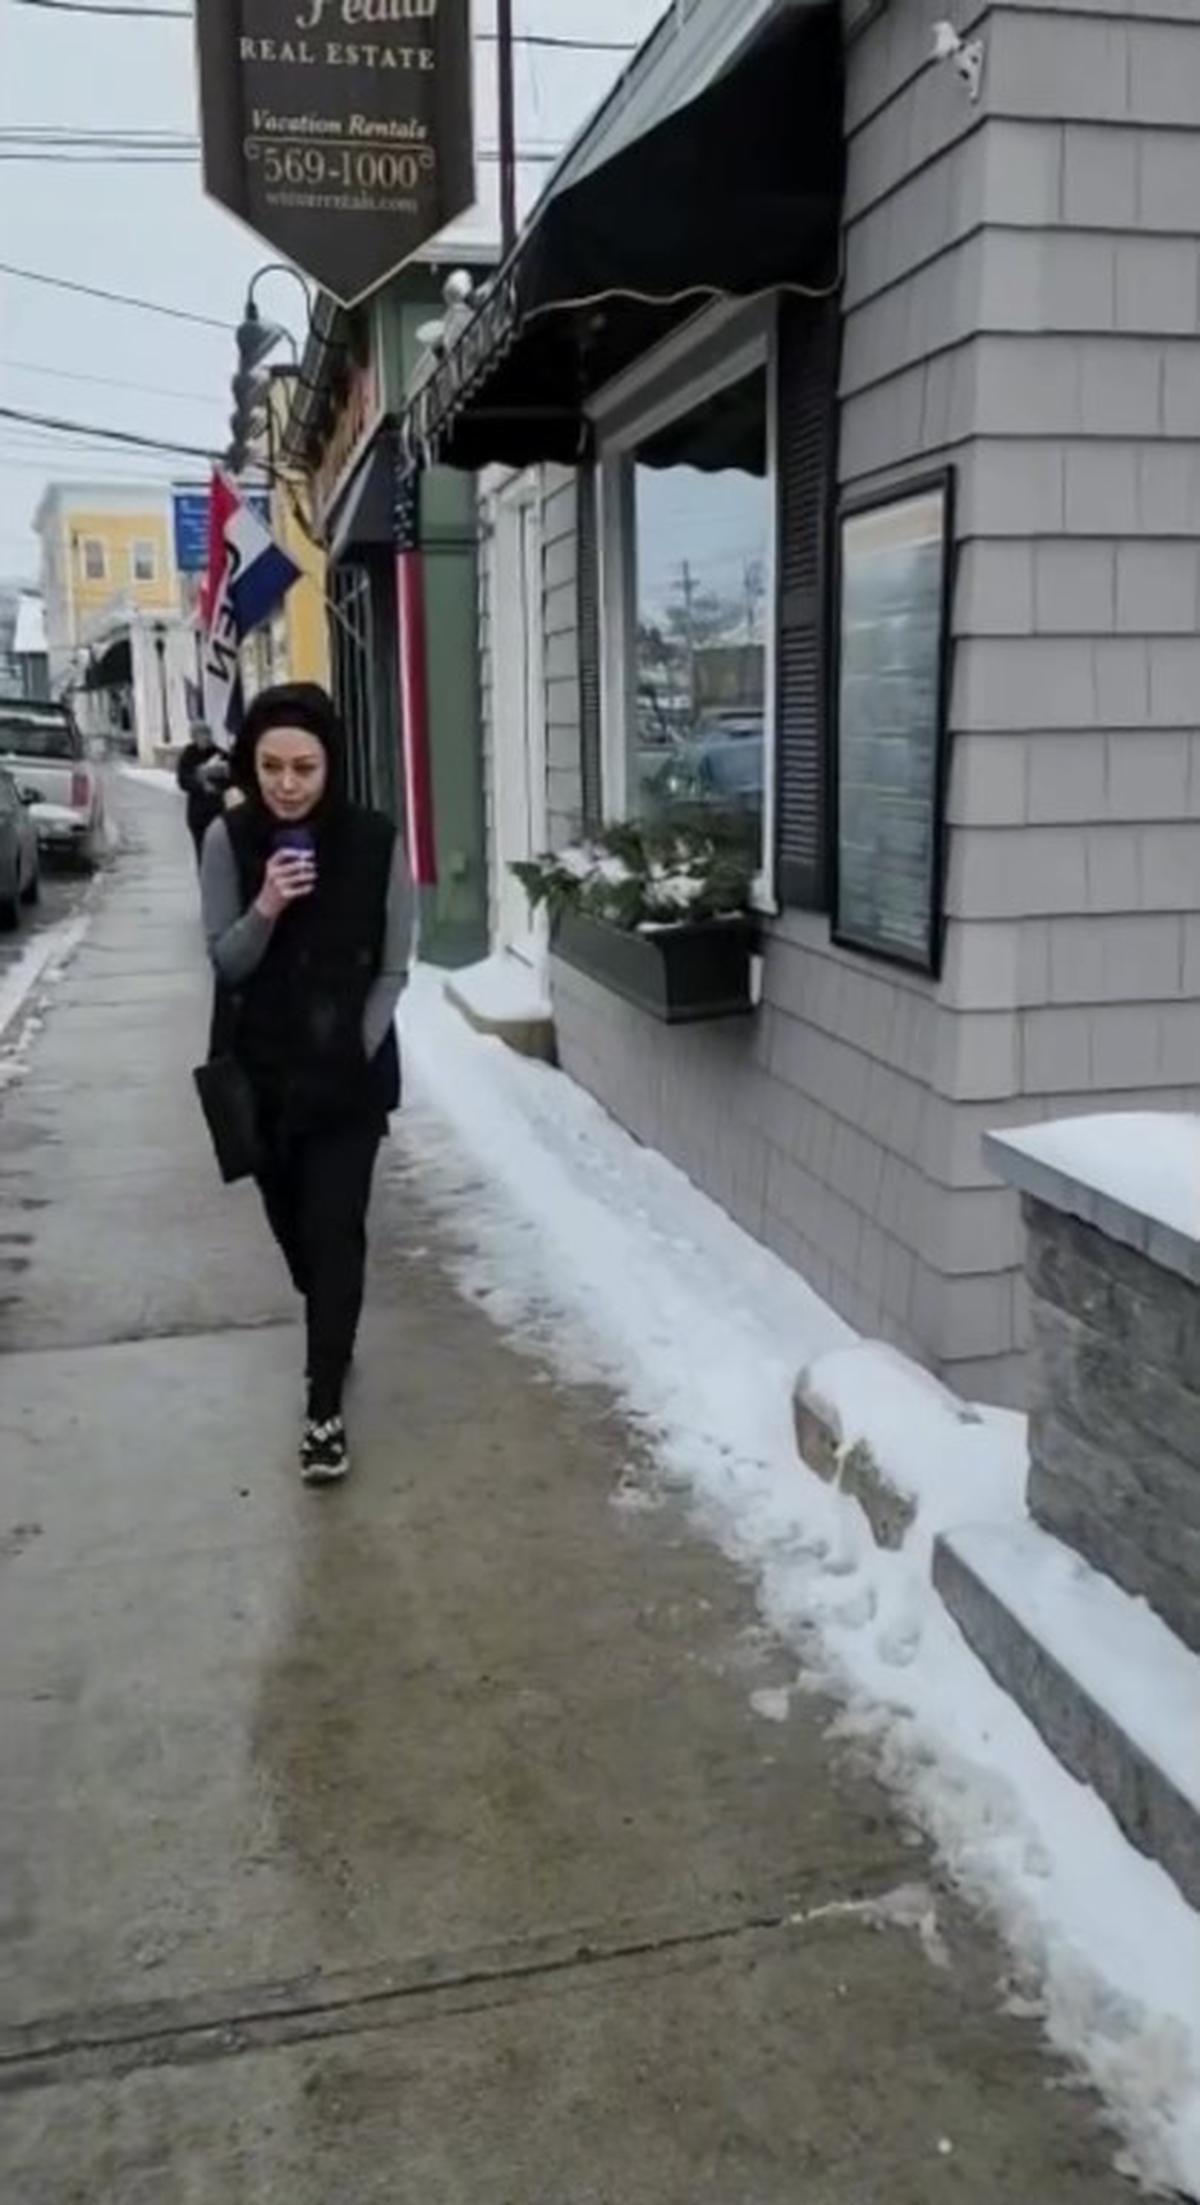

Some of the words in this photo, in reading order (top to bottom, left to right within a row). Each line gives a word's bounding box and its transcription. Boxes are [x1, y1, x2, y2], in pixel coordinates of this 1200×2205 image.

[240, 36, 315, 64] REAL
[326, 43, 436, 70] ESTATE
[252, 109, 342, 134] Vacation
[350, 114, 427, 139] Rentals
[264, 149, 418, 188] 569-1000
